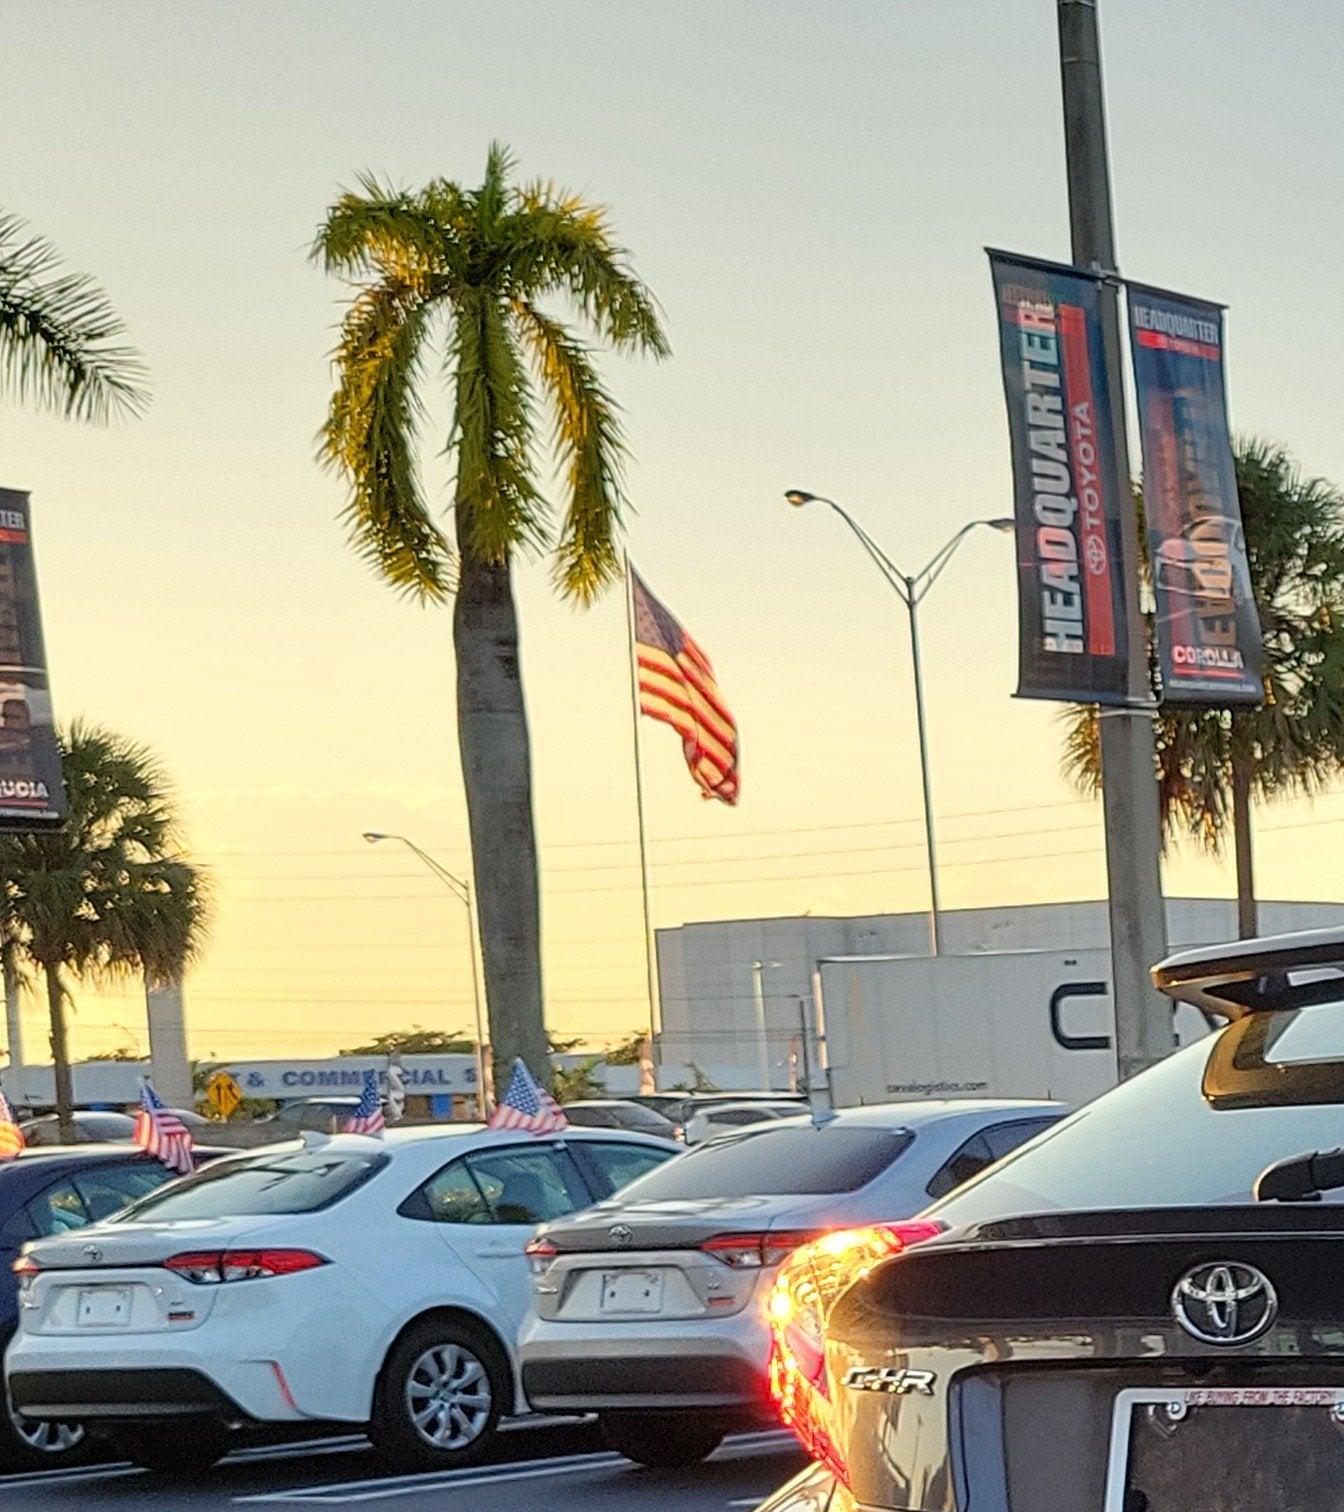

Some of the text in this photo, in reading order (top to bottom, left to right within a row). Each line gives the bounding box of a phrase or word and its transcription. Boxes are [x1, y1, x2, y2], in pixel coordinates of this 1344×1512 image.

[1134, 304, 1219, 346] HEADQUARTER
[1018, 301, 1085, 654] HEADQUARTER
[1072, 401, 1101, 531] TOYOTA
[1172, 645, 1244, 669] COROLLA
[0, 780, 49, 799] UOIA
[281, 1068, 450, 1087] COMMCIAL
